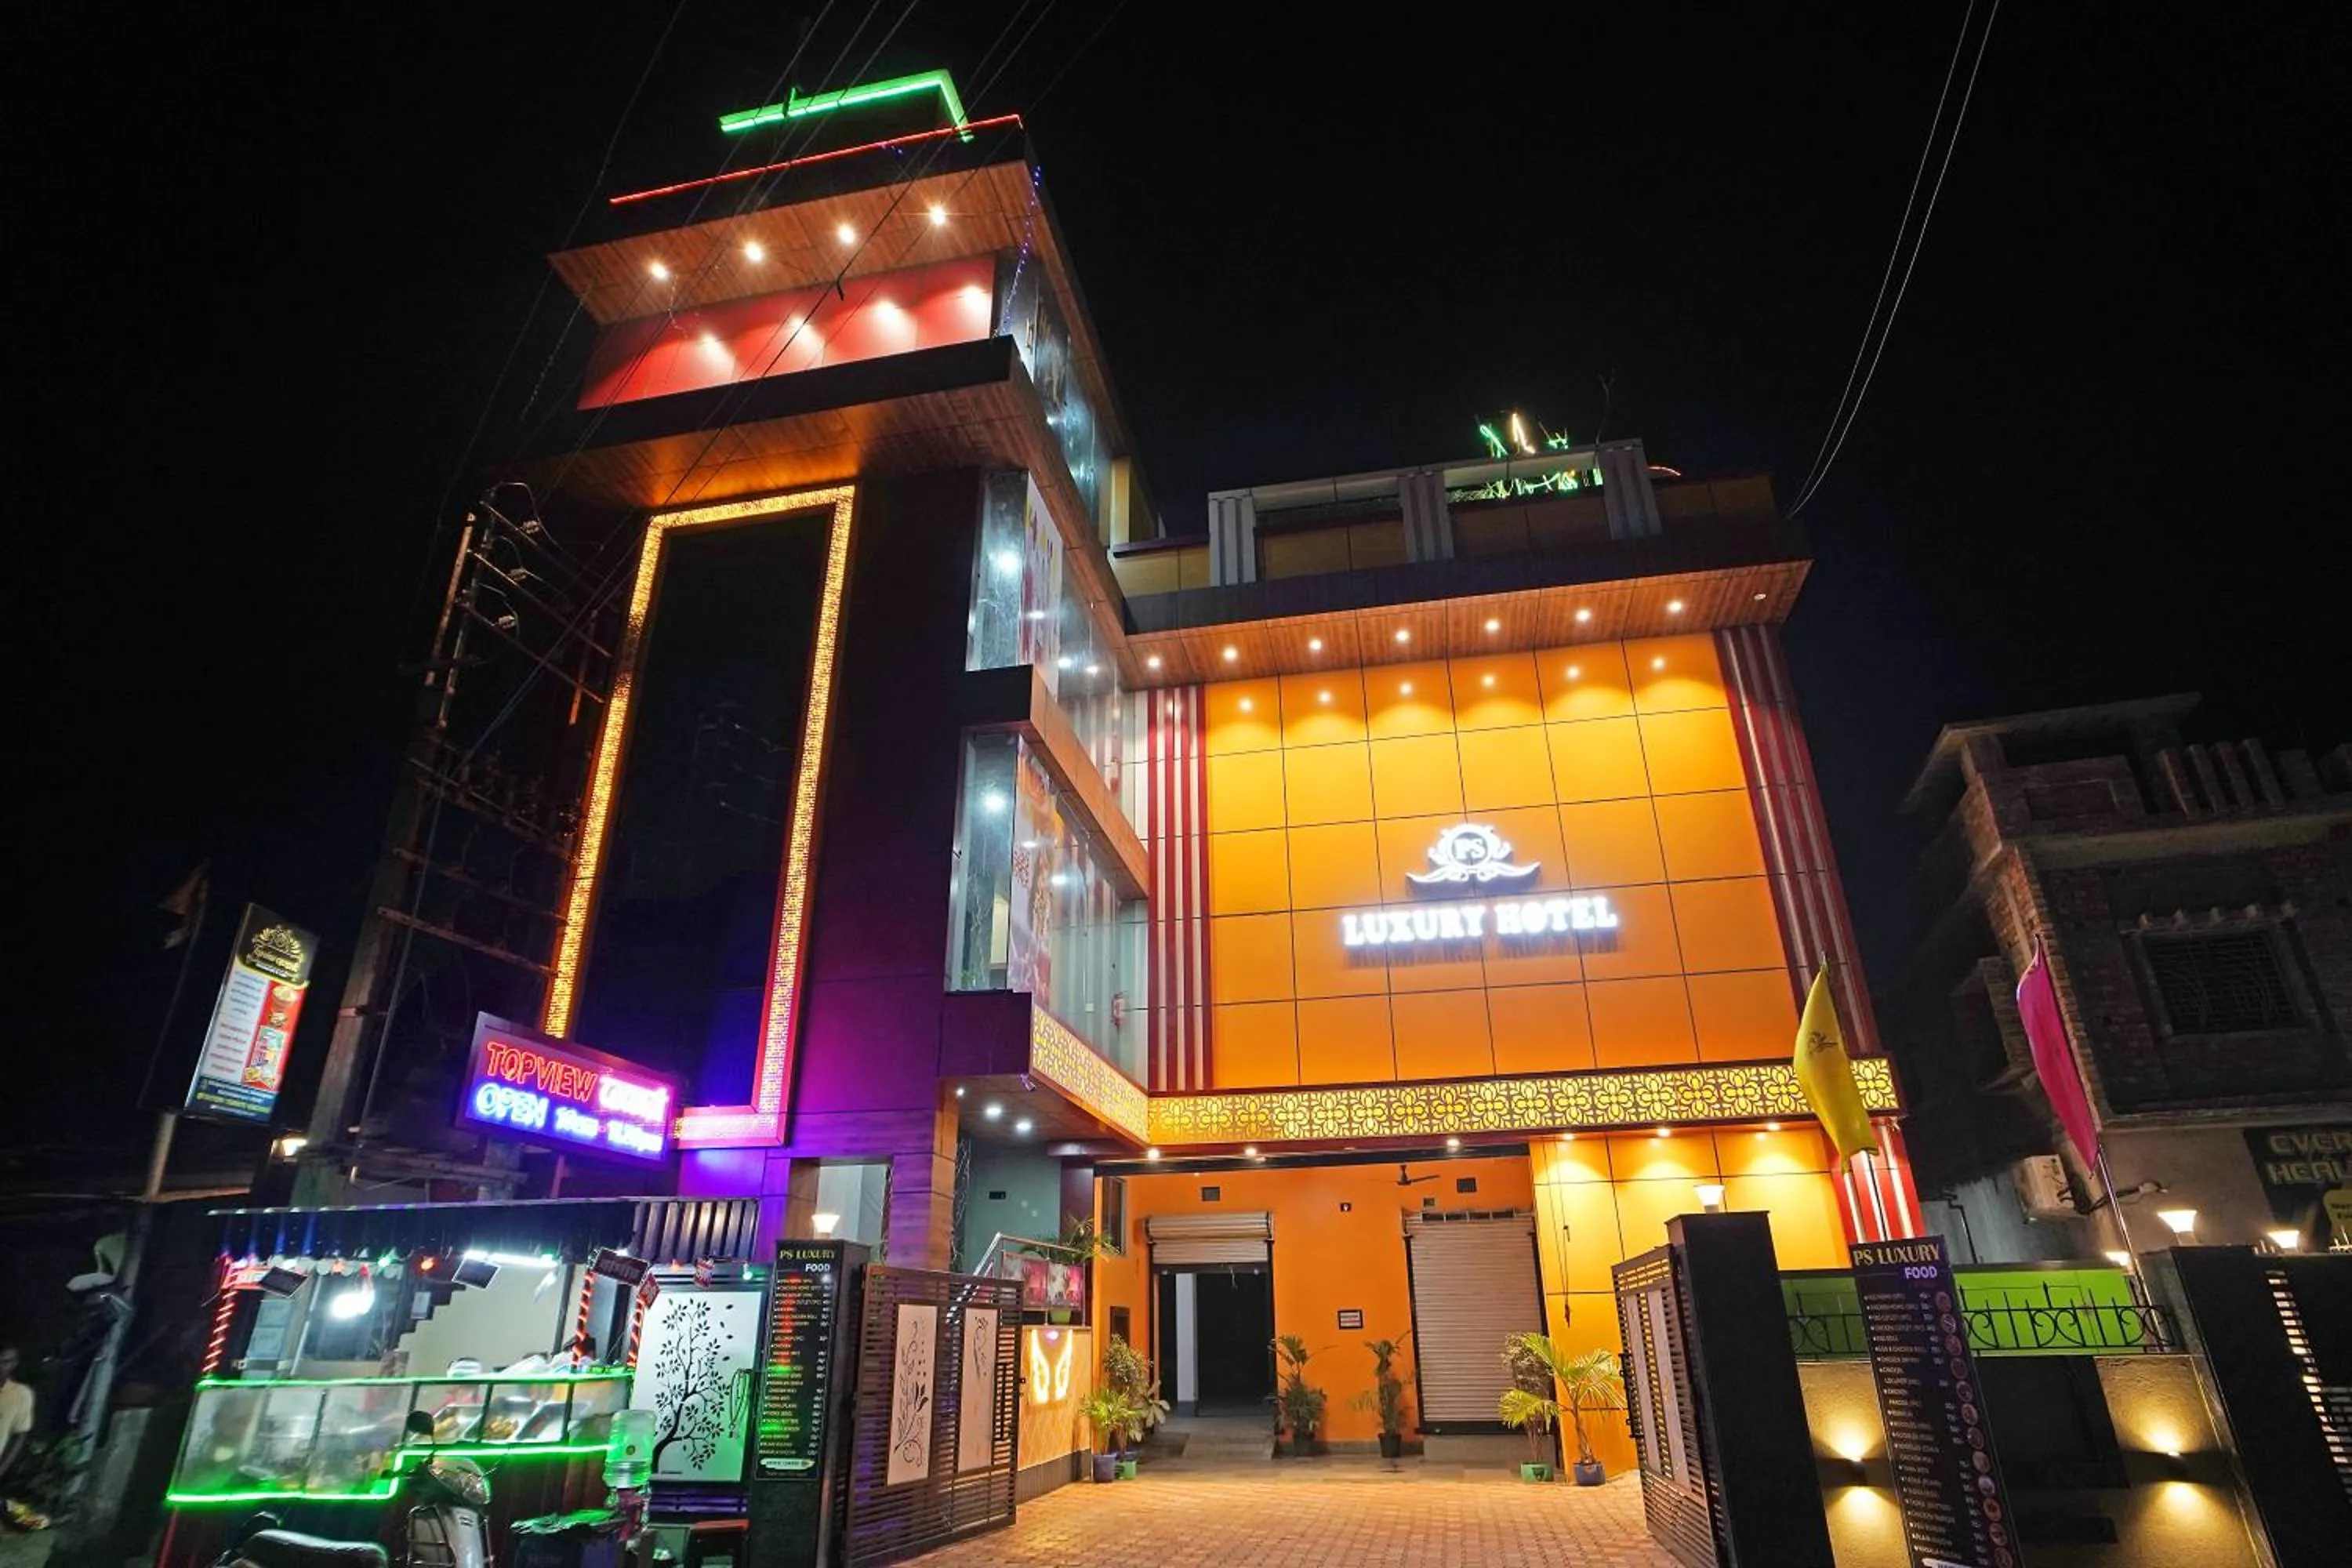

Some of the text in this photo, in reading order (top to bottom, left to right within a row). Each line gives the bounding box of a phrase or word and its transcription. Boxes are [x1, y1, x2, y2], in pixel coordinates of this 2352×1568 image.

[1454, 837, 1488, 860] PS
[1342, 897, 1618, 946] LUXURY HOTEL
[487, 1041, 598, 1102] TOPVIEW
[477, 1083, 549, 1129] OPEN
[779, 1250, 793, 1260] PS
[1853, 1243, 1940, 1266] PS LUXURY
[805, 1263, 831, 1272] FOOD
[1904, 1265, 1938, 1279] FOOD
